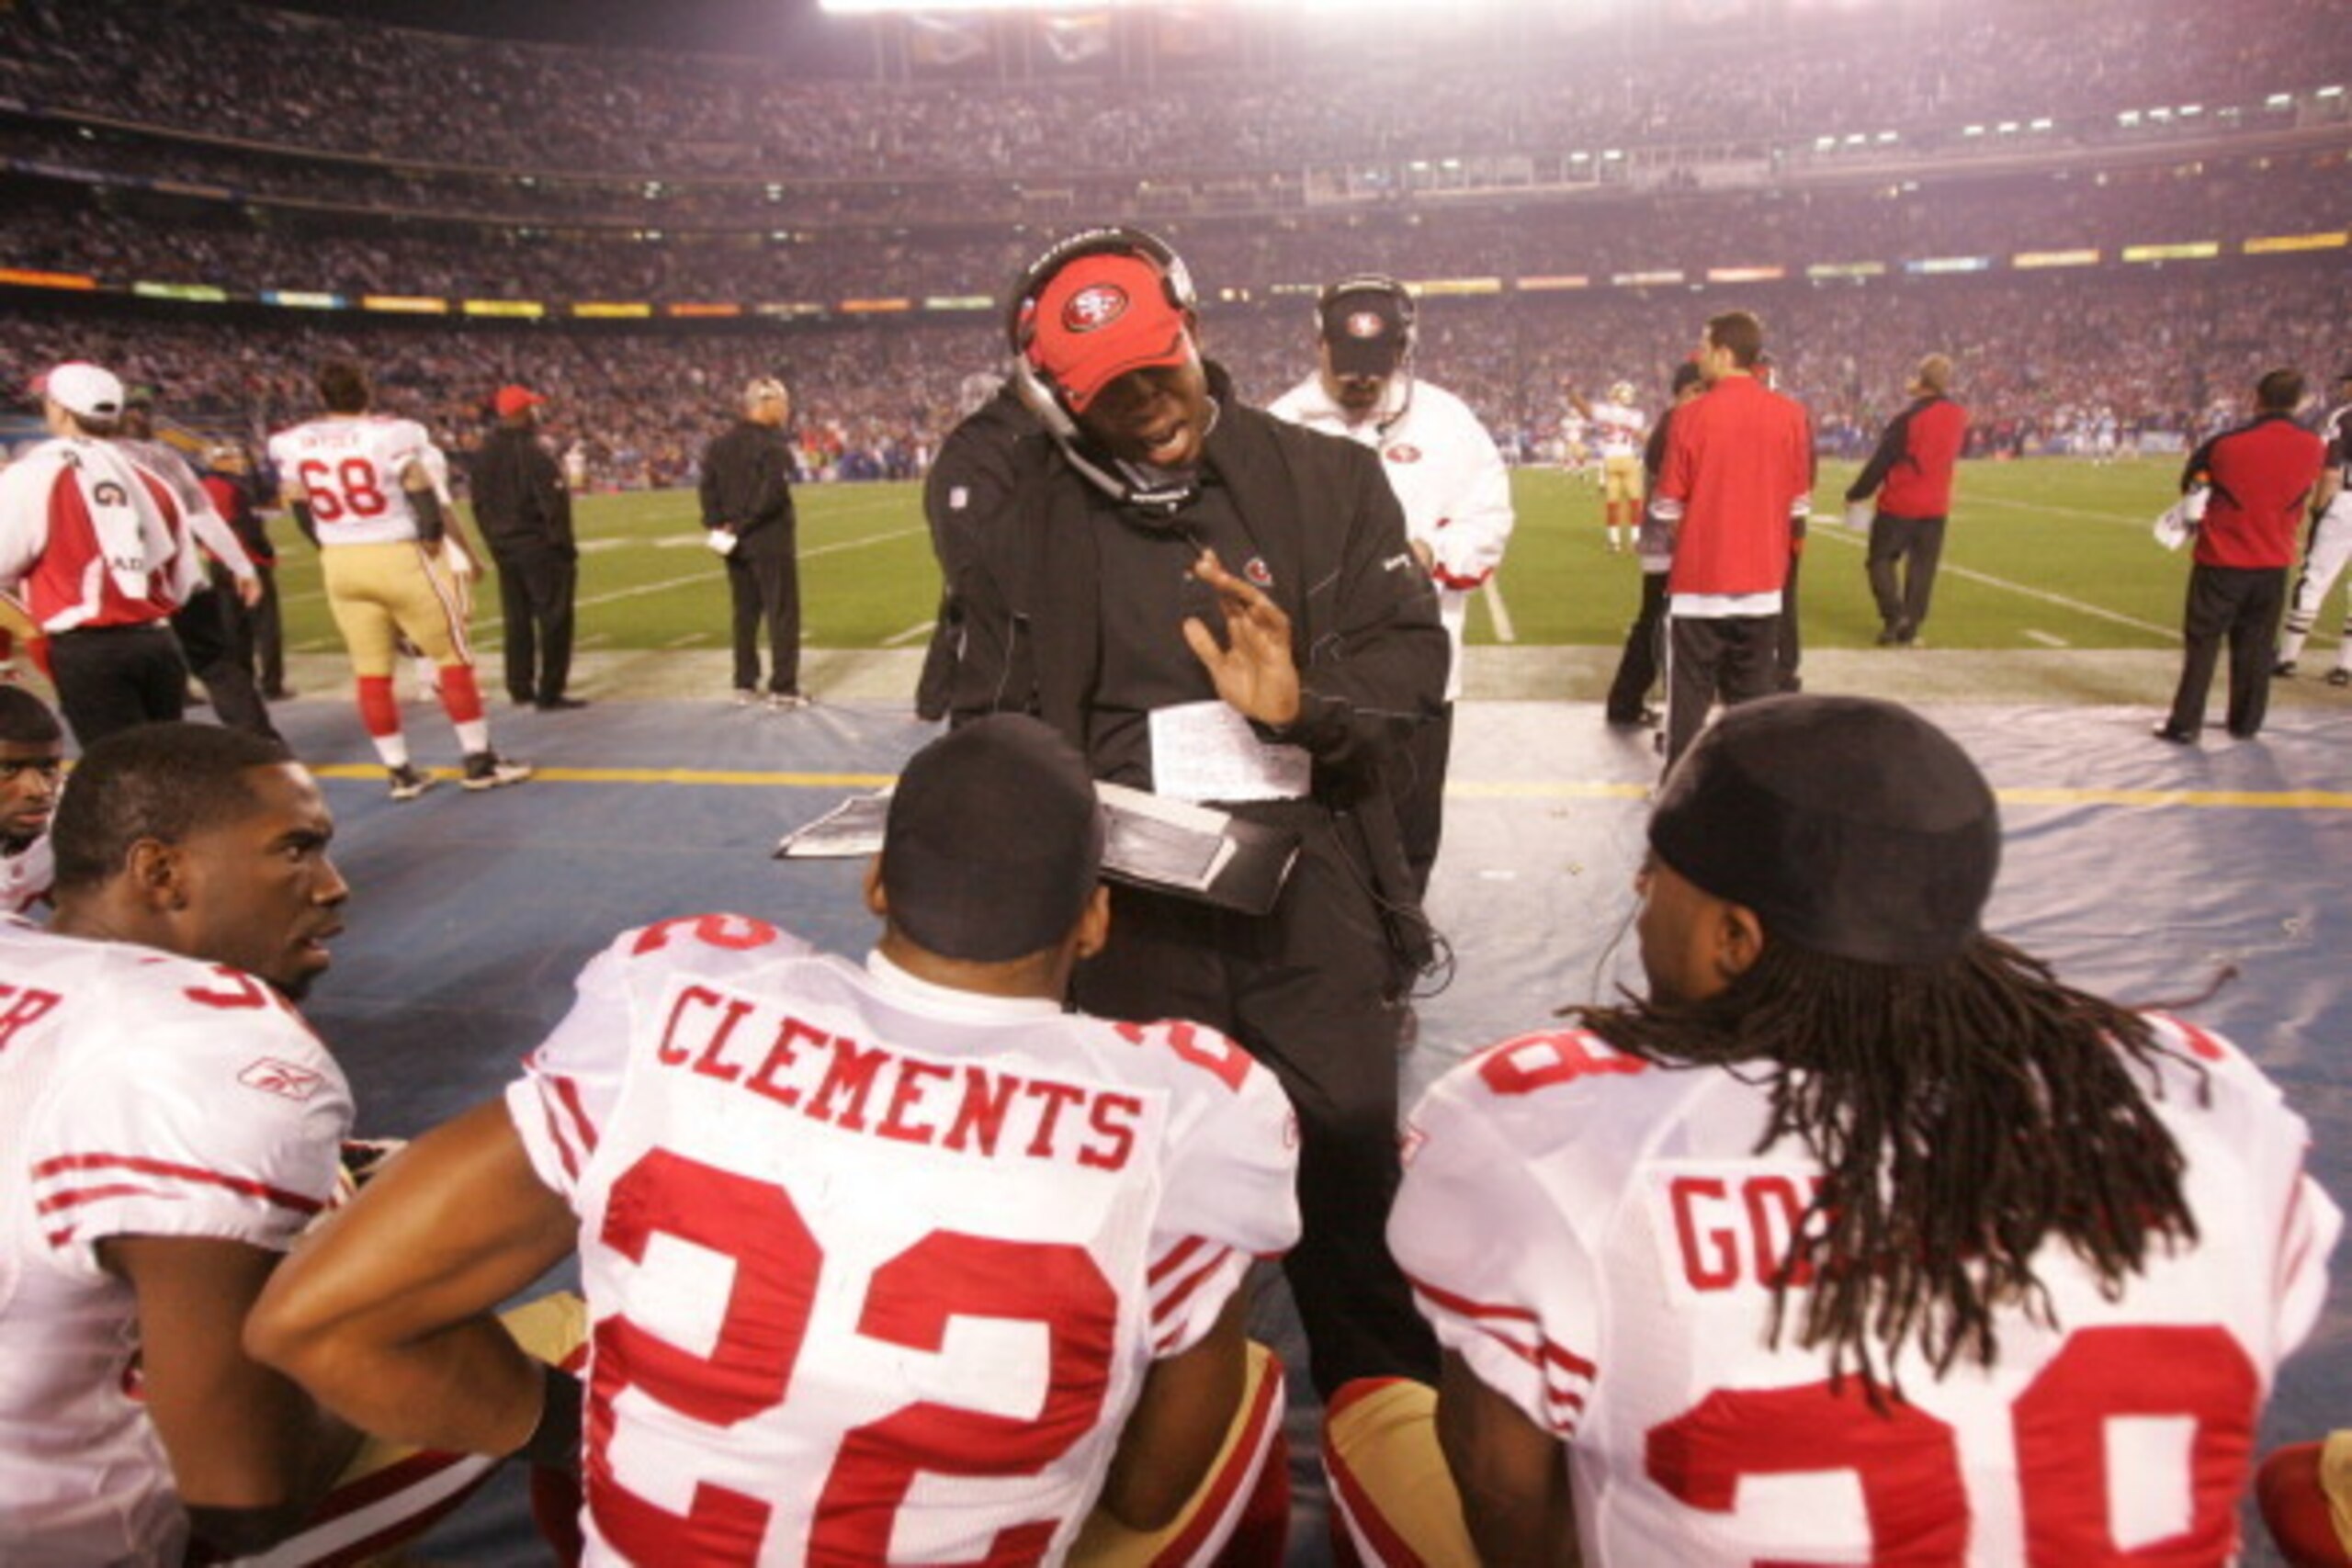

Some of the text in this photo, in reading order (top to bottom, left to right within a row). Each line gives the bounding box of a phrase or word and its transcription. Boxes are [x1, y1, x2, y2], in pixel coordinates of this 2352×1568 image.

[299, 457, 388, 522] 68
[657, 984, 1142, 1172] CLEMENTS
[585, 1146, 1119, 1568] 22
